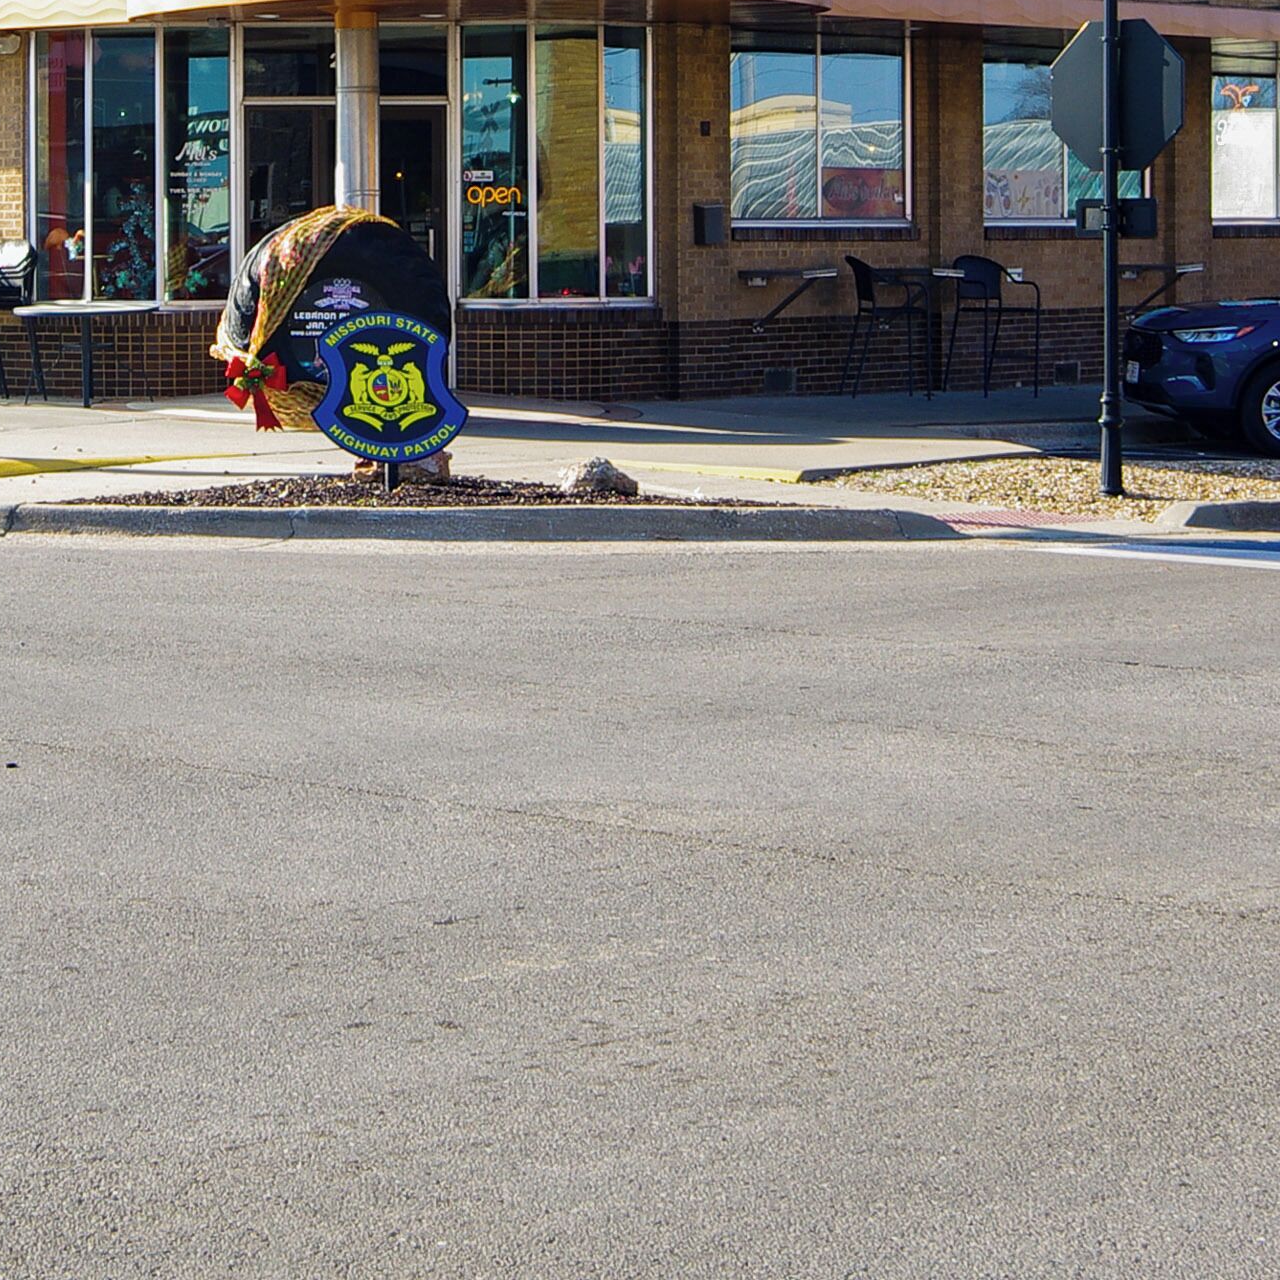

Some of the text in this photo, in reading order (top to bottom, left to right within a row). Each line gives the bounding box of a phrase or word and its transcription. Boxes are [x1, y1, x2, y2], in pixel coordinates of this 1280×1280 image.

[467, 186, 521, 208] open
[325, 315, 439, 347] MISSOURI STATE
[329, 423, 457, 458] HIGHWAY PATROL
